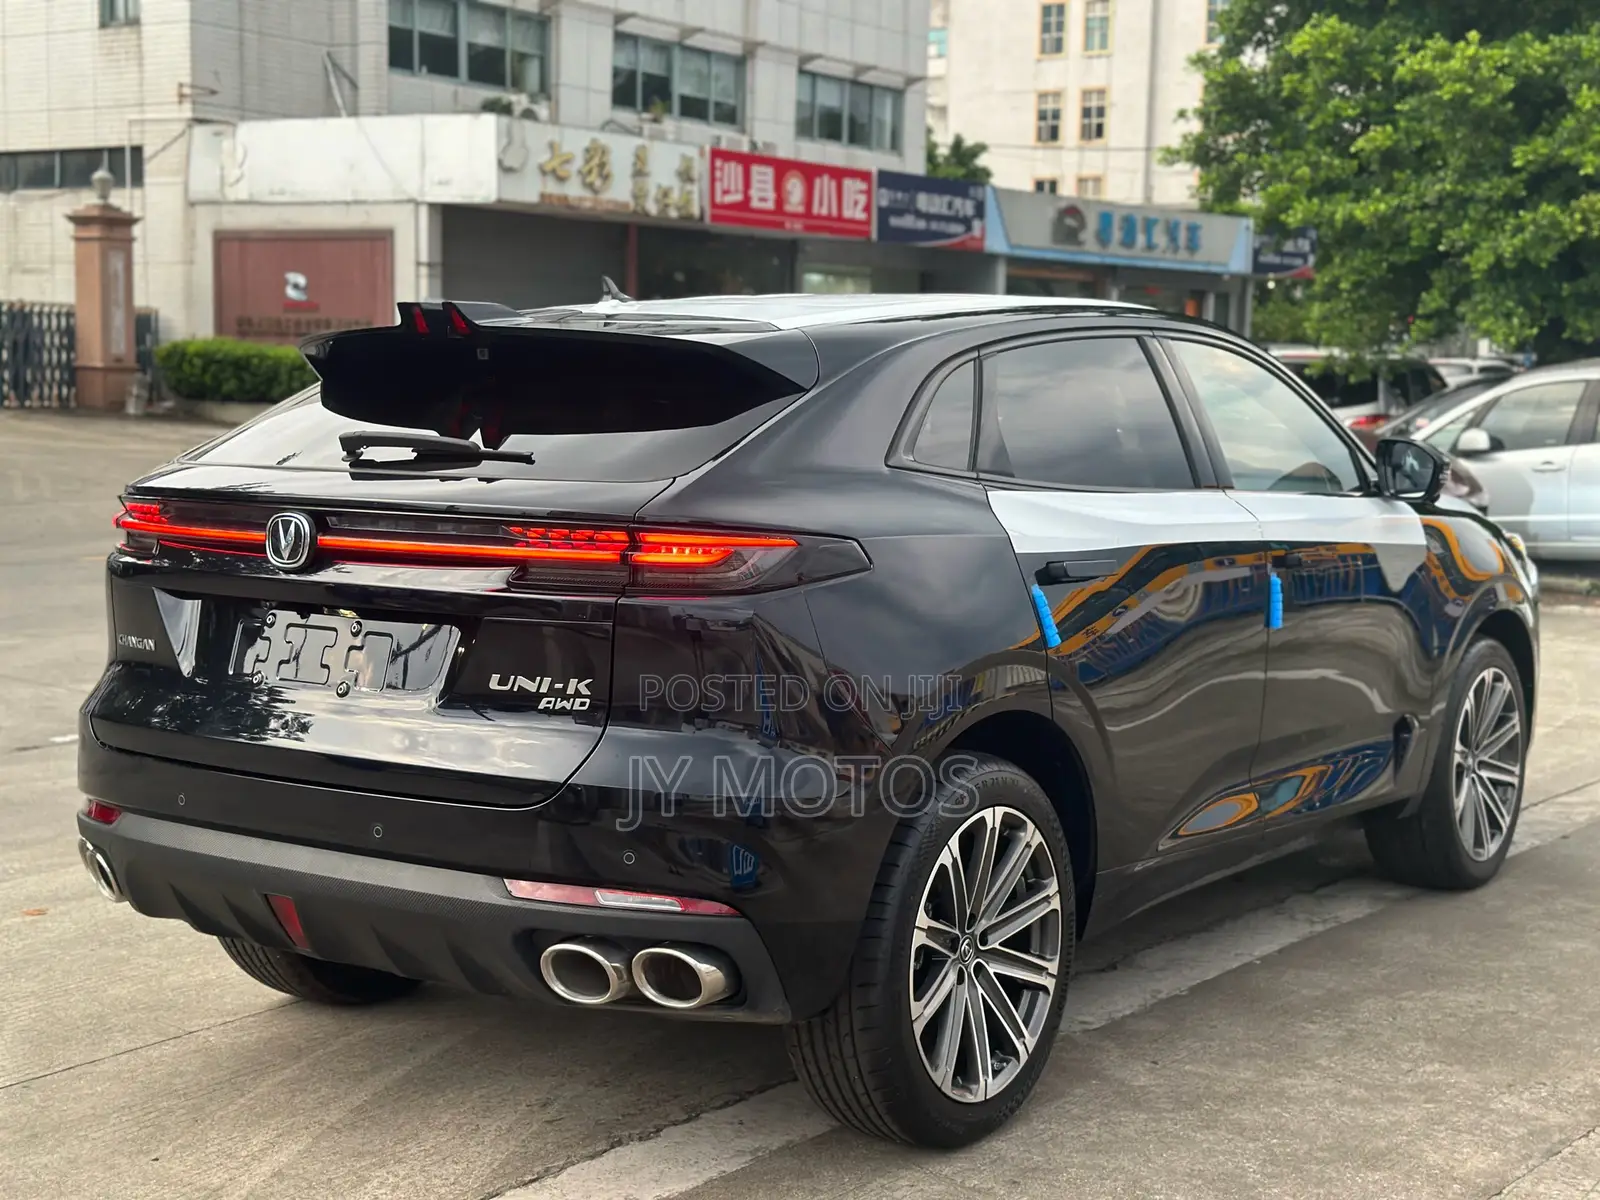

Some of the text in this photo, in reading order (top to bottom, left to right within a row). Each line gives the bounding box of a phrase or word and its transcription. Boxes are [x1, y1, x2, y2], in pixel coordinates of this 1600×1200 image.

[714, 157, 776, 211] 沙县
[811, 174, 869, 221] 小吃
[119, 633, 156, 651] CHANGAN
[489, 674, 593, 695] UNI-K
[537, 697, 591, 711] AWD
